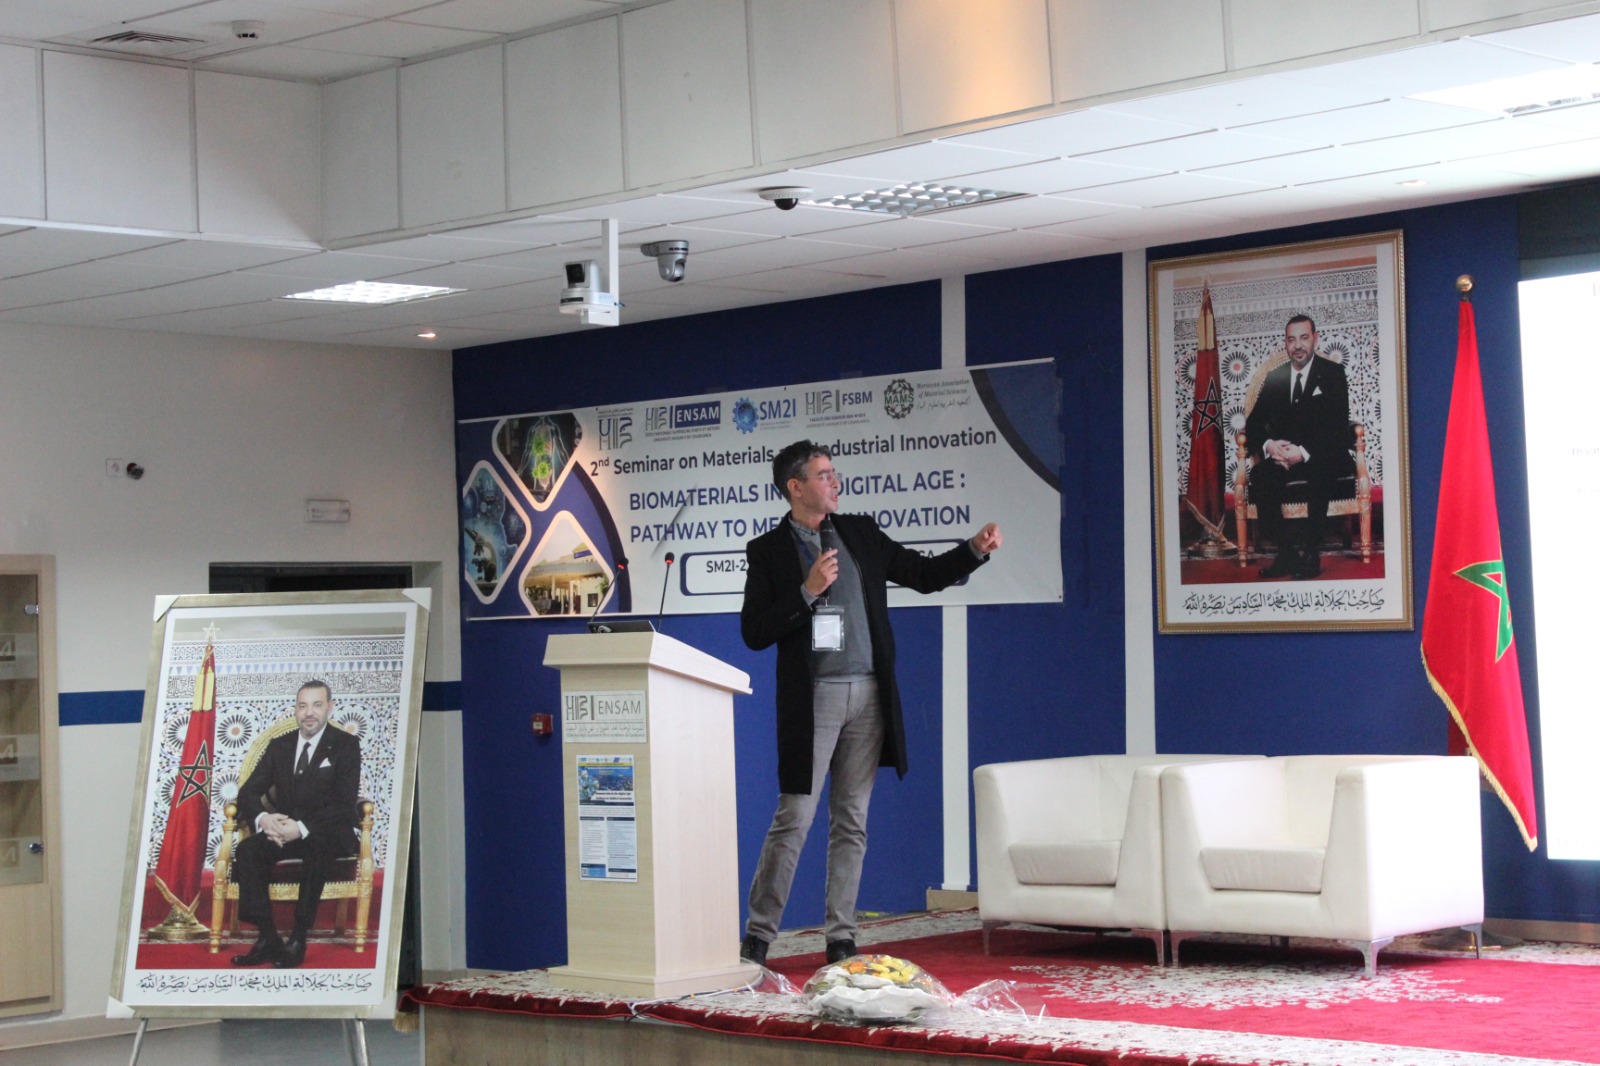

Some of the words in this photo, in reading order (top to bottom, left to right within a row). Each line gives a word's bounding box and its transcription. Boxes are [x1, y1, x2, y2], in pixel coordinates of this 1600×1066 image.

[842, 391, 872, 405] FSBM
[885, 393, 914, 406] MAMS
[676, 406, 719, 422] ENSAM
[759, 399, 796, 420] SM2I
[900, 427, 996, 451] Innovation
[591, 457, 609, 476] 2nd
[614, 455, 675, 475] Seminar
[679, 456, 697, 469] on
[703, 446, 774, 468] Materials
[913, 470, 954, 491] AGE
[630, 484, 759, 510] BIOMATERIALS
[765, 483, 782, 501] IN
[631, 521, 718, 542] PATHWAY
[723, 519, 747, 537] TO
[598, 700, 641, 715] ENSAM
